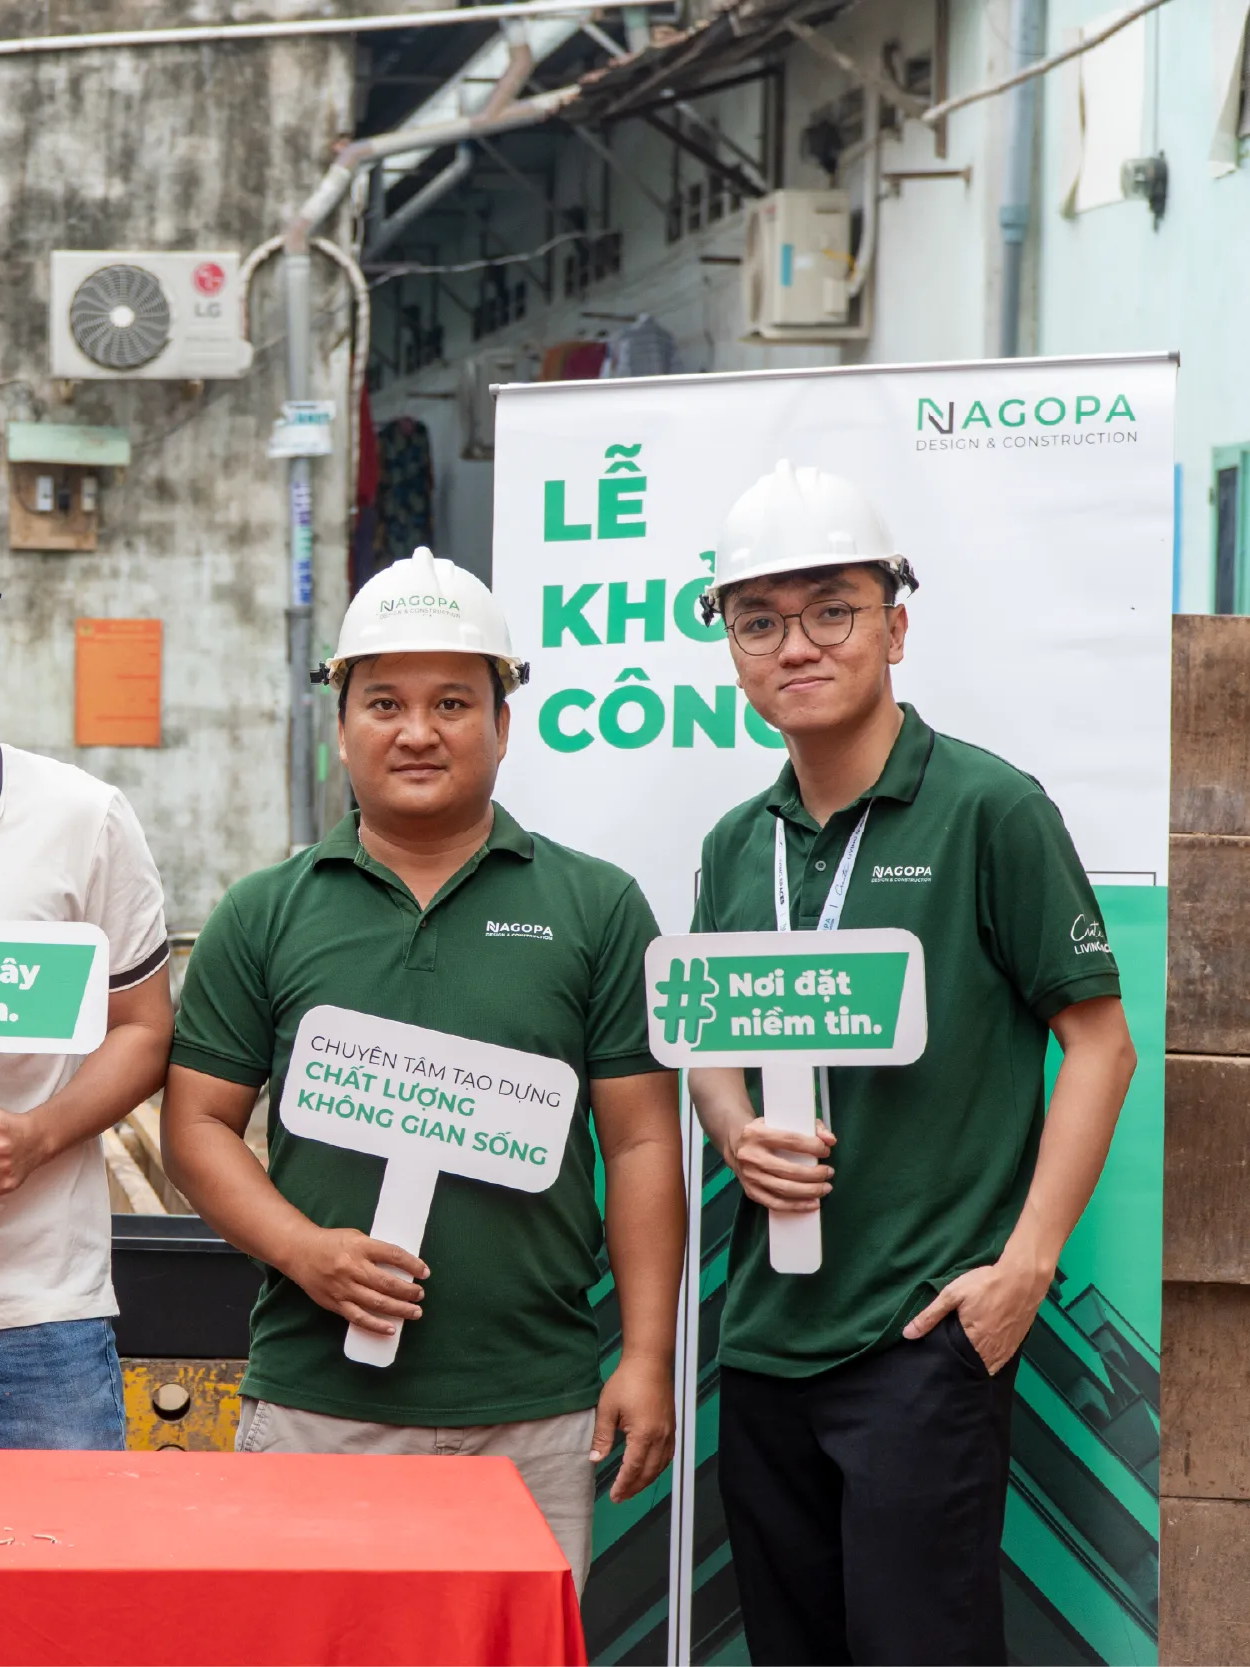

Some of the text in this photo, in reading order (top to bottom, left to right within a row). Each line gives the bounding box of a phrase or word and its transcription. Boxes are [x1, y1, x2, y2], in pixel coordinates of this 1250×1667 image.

[194, 302, 222, 317] LG
[917, 394, 1136, 434] NAGOPA
[916, 431, 1138, 451] DESIGN & CONSTRUCTION
[544, 443, 647, 542] LỄ
[380, 596, 460, 612] NAGOPA
[542, 551, 729, 648] KHỞ
[872, 866, 932, 878] NAGOPA
[486, 920, 553, 936] NAGOPA
[728, 968, 852, 1003] Nơi đặt
[730, 1006, 882, 1036] niềm tin.
[305, 1061, 476, 1117] CHẤT LƯỢNG
[311, 1035, 562, 1108] CHUYÊN TÂM TẠO DỰNG
[297, 1089, 548, 1165] KHÔNG GIAN SỐNG
